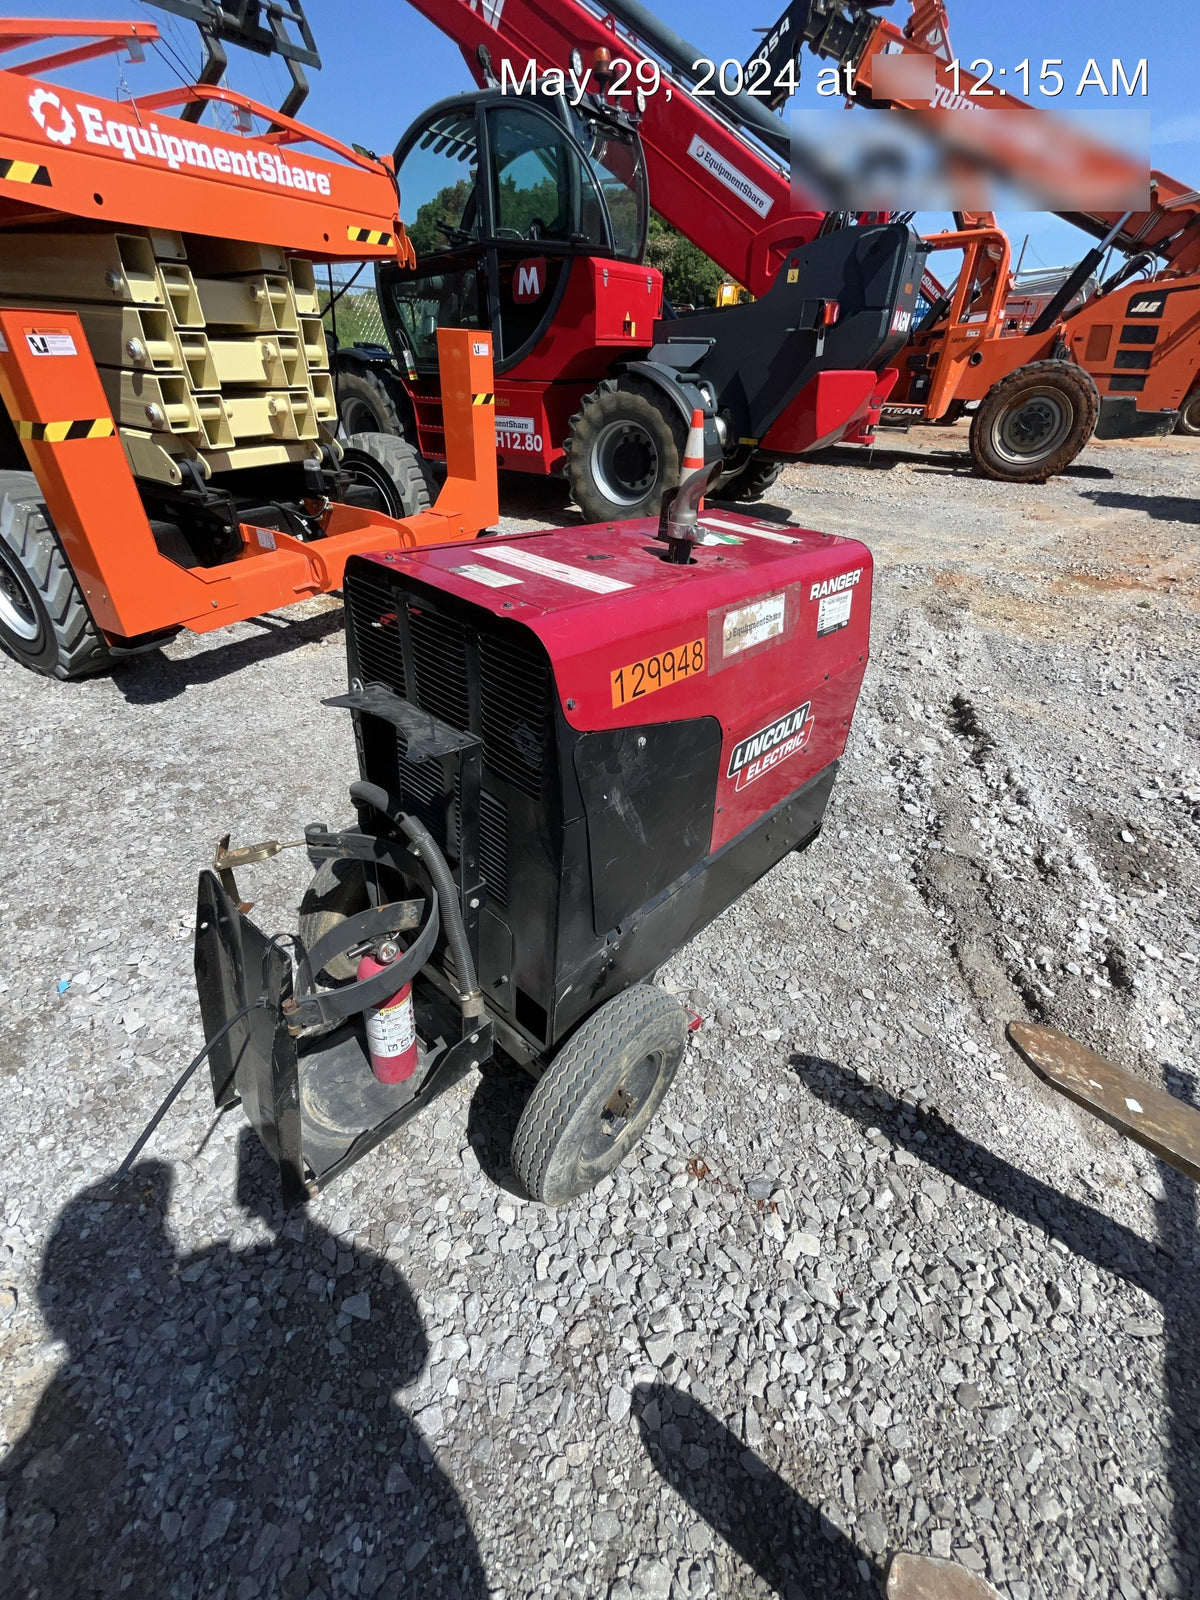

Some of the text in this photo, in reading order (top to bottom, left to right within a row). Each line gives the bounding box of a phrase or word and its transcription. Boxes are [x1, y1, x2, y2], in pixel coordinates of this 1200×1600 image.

[76, 104, 331, 196] EquipmentShare
[703, 151, 764, 208] EquipmentShare
[518, 266, 540, 295] M
[809, 568, 862, 601] RANGER
[732, 611, 782, 638] EquipmentShare
[614, 640, 703, 703] 129948
[733, 708, 806, 771] LINCOLN
[745, 730, 806, 781] ELECTRIC
